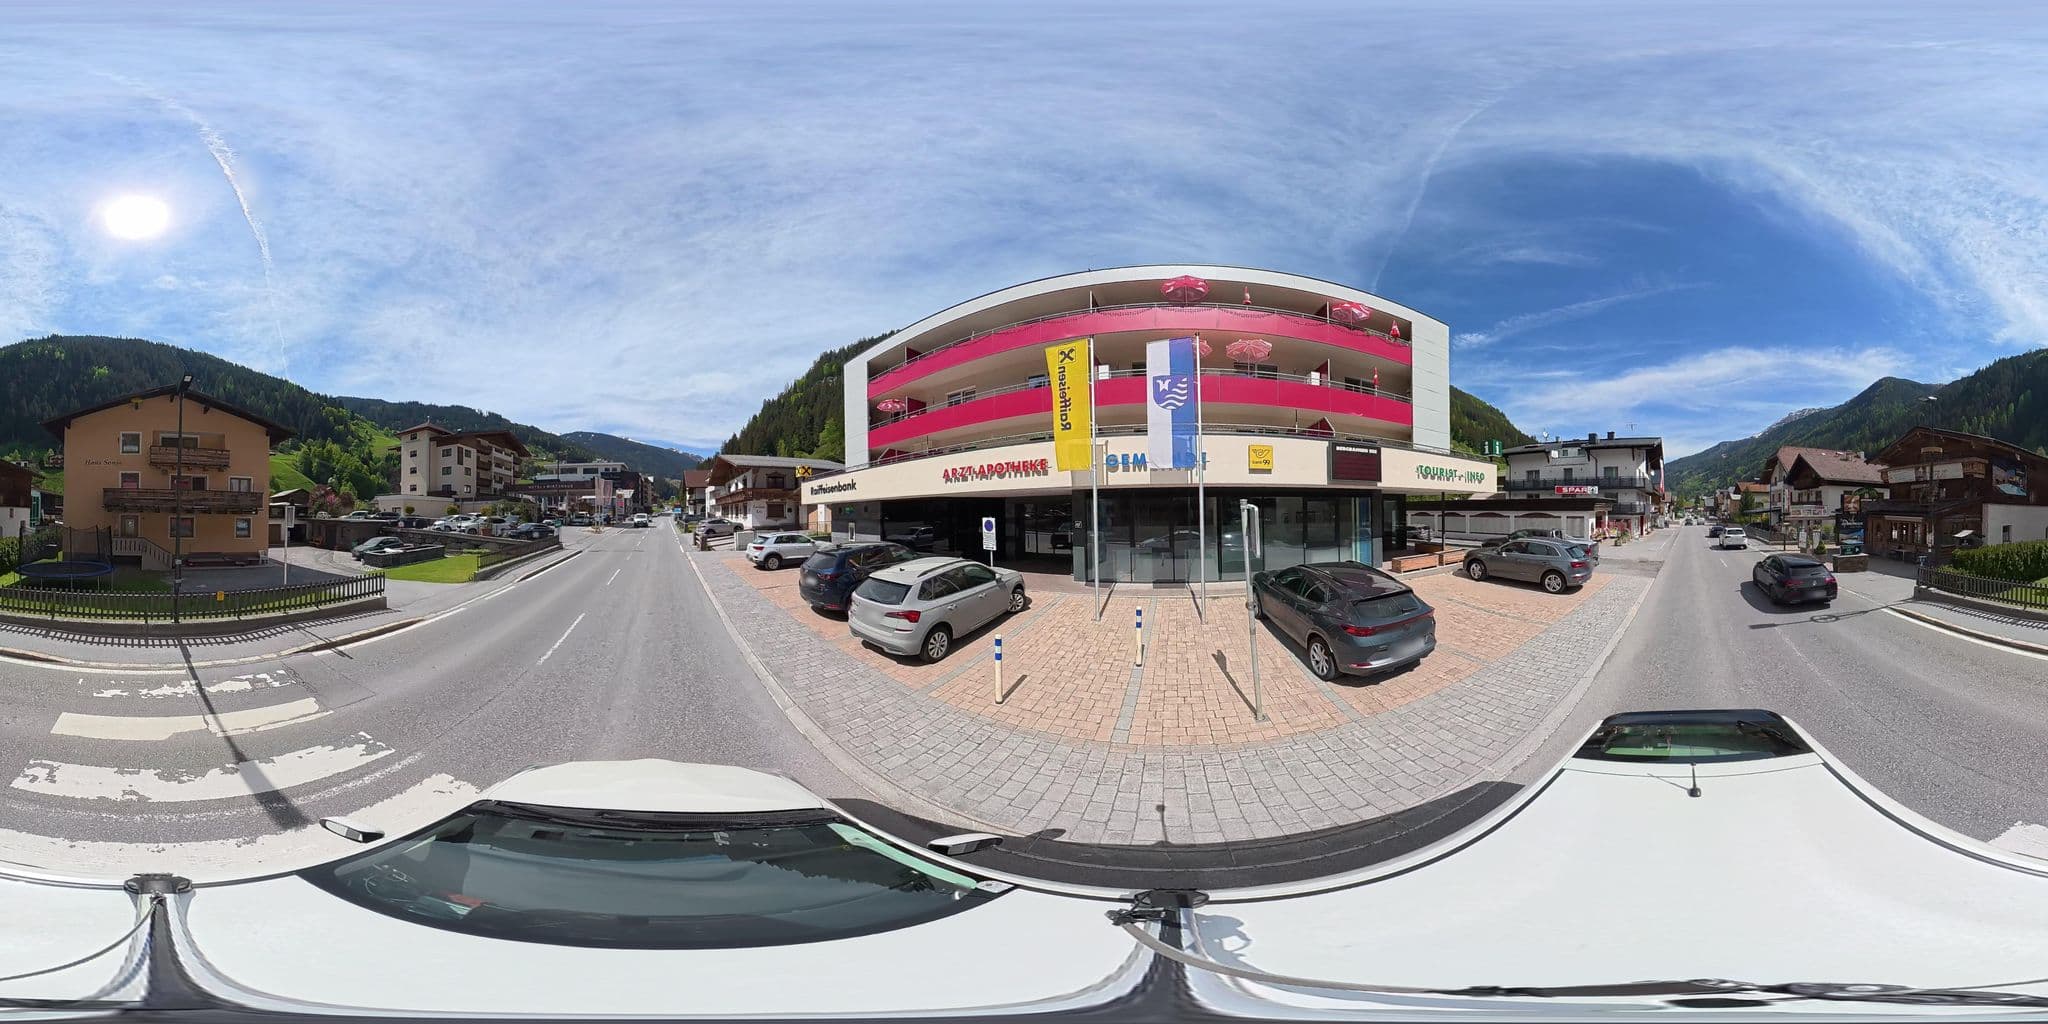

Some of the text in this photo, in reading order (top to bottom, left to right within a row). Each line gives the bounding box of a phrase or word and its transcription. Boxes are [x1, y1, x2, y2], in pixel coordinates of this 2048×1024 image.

[1418, 465, 1457, 478] TOURIST
[1467, 471, 1485, 481] INFO
[811, 479, 857, 495] Raiffeisenbank
